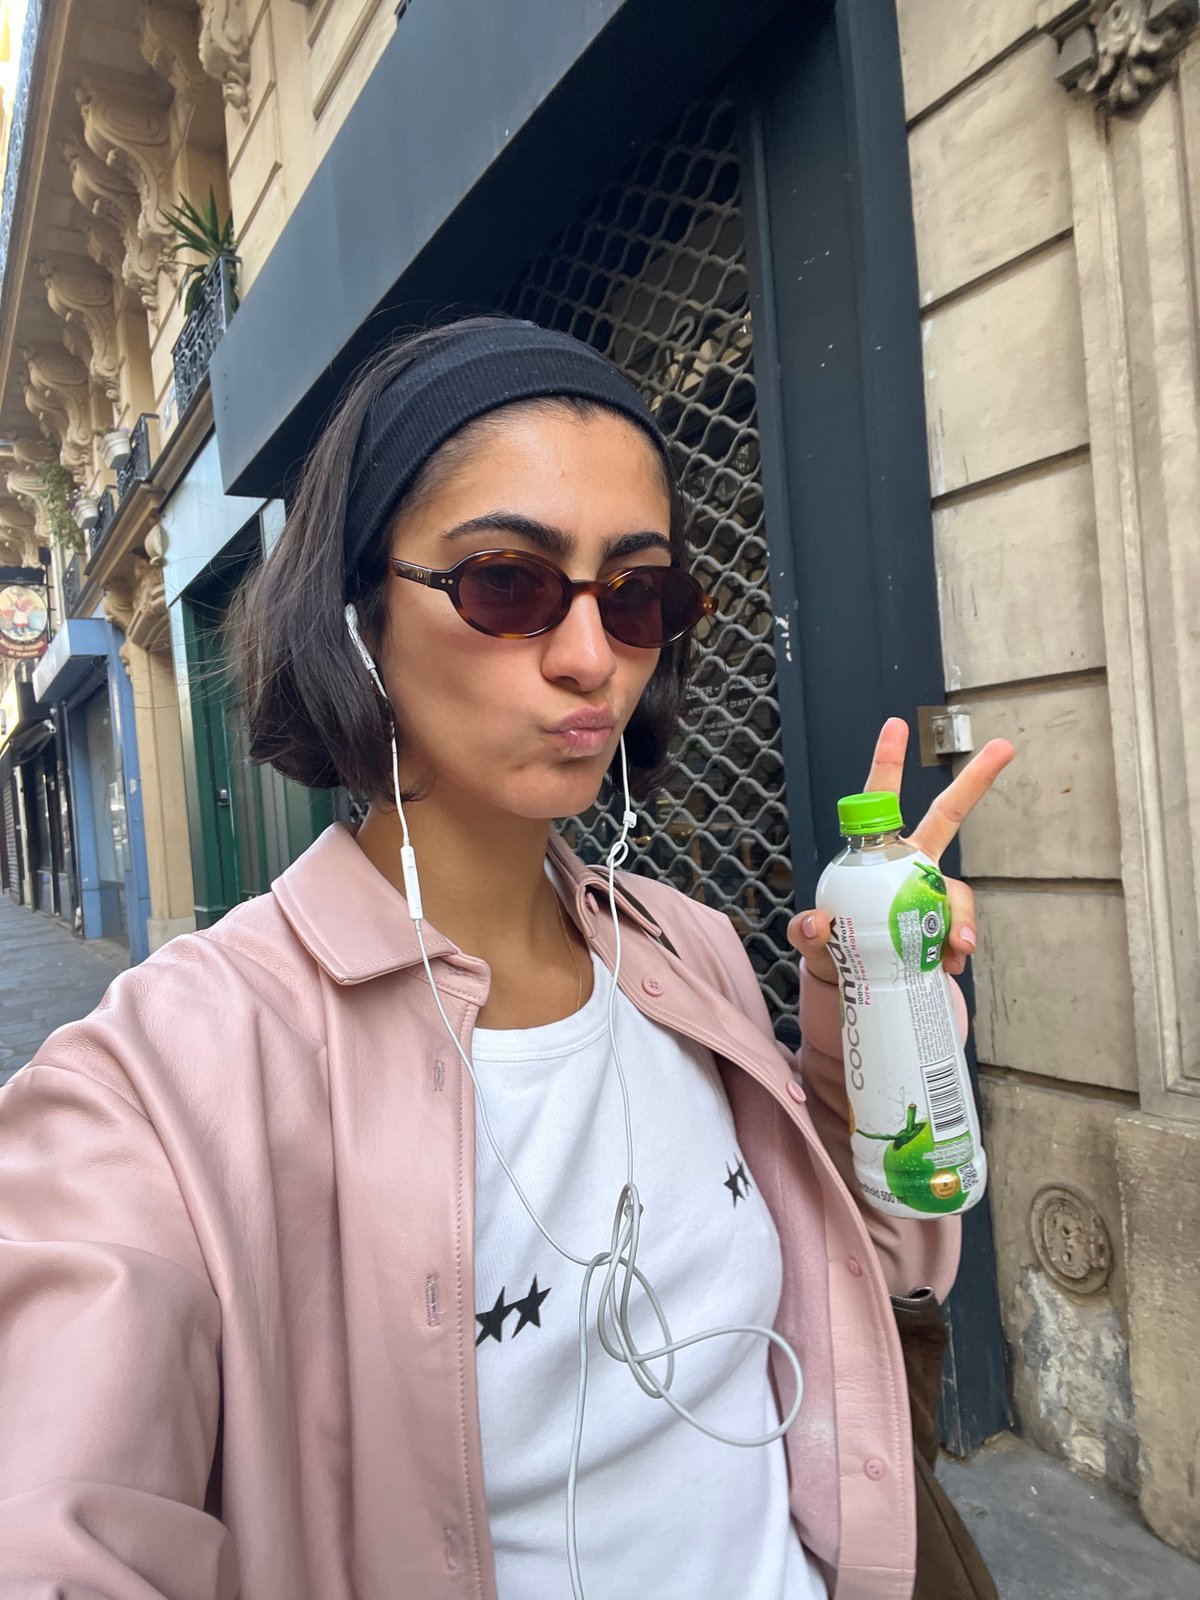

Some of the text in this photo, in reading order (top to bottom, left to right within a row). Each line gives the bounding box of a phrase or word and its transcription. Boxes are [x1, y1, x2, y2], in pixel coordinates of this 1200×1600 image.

[845, 917, 857, 951] Natural
[839, 916, 865, 1005] 100% Coconut Water
[881, 1190, 896, 1204] 500
